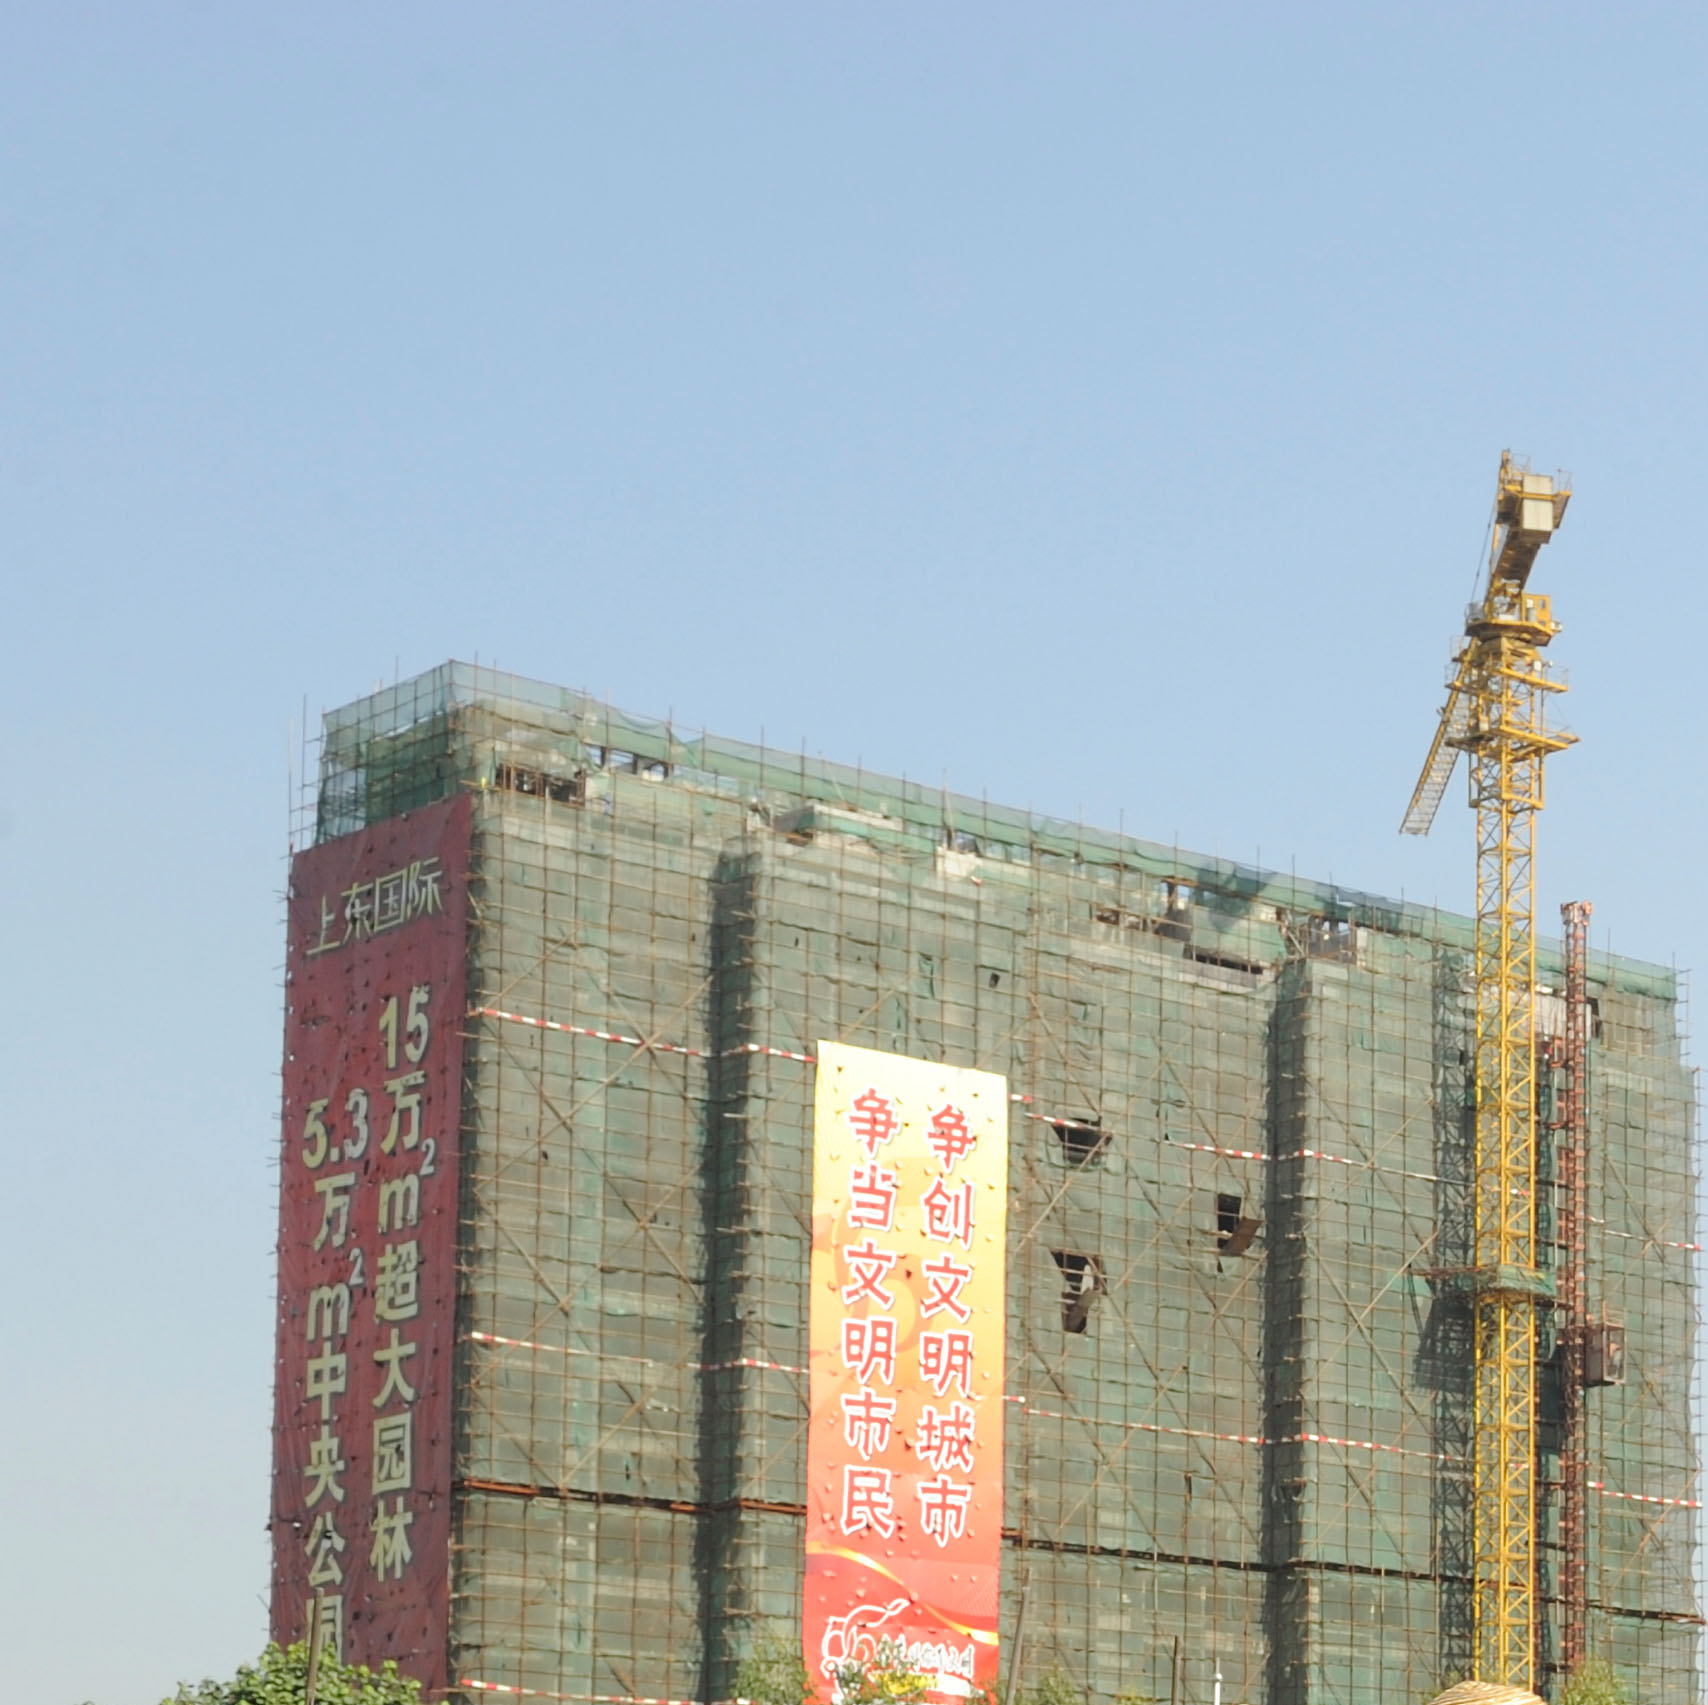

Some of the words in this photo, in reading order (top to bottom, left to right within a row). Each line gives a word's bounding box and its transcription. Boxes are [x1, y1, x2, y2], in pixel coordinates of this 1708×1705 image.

[305, 857, 443, 956] 上东国际
[839, 1087, 899, 1540] 争当文明市民
[916, 1104, 976, 1548] 争创文明城市
